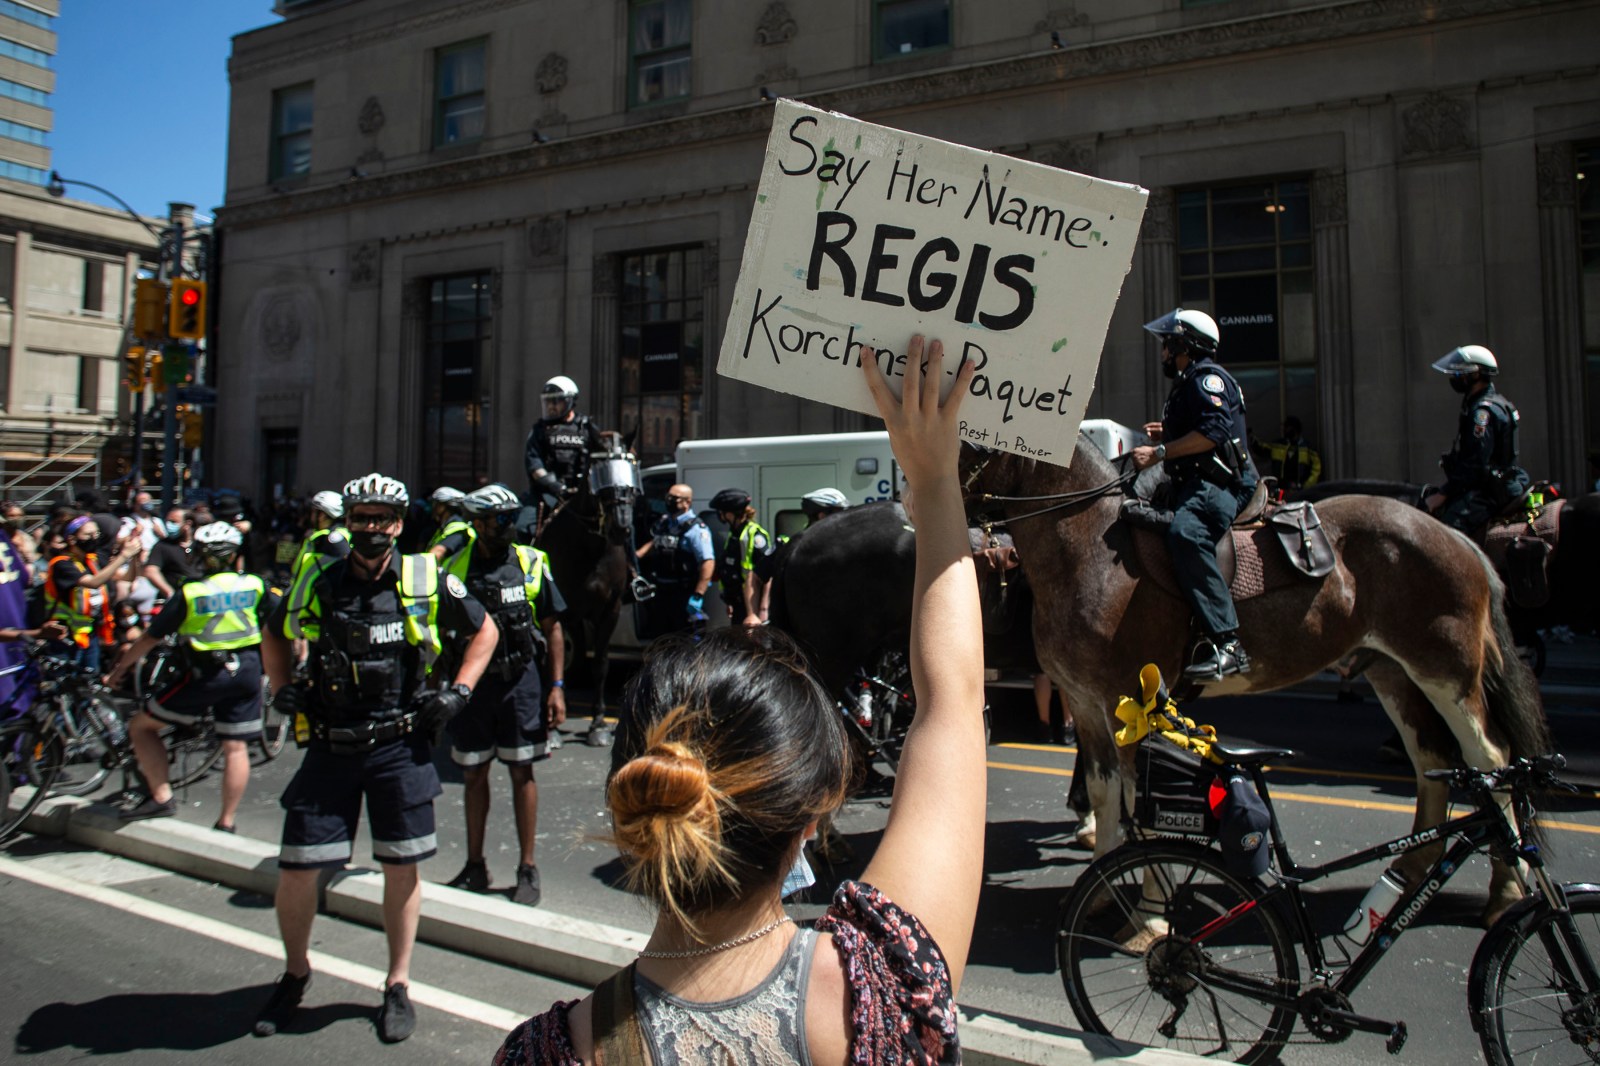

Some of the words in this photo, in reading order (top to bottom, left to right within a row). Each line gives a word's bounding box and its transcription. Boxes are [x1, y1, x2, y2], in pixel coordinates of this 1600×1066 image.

[779, 116, 870, 210] Say
[887, 157, 957, 208] Her
[964, 165, 1114, 248] Name:
[806, 211, 1035, 330] REGIS
[1219, 314, 1274, 326] CANNABIS
[959, 420, 989, 441] Rest
[994, 432, 1008, 448] In
[1014, 436, 1053, 457] Power
[501, 585, 525, 604] POLICE
[369, 621, 404, 644] POLICE
[1158, 813, 1201, 828] POLICE
[1388, 828, 1439, 854] POLICE
[1392, 879, 1440, 932] TORONTO
